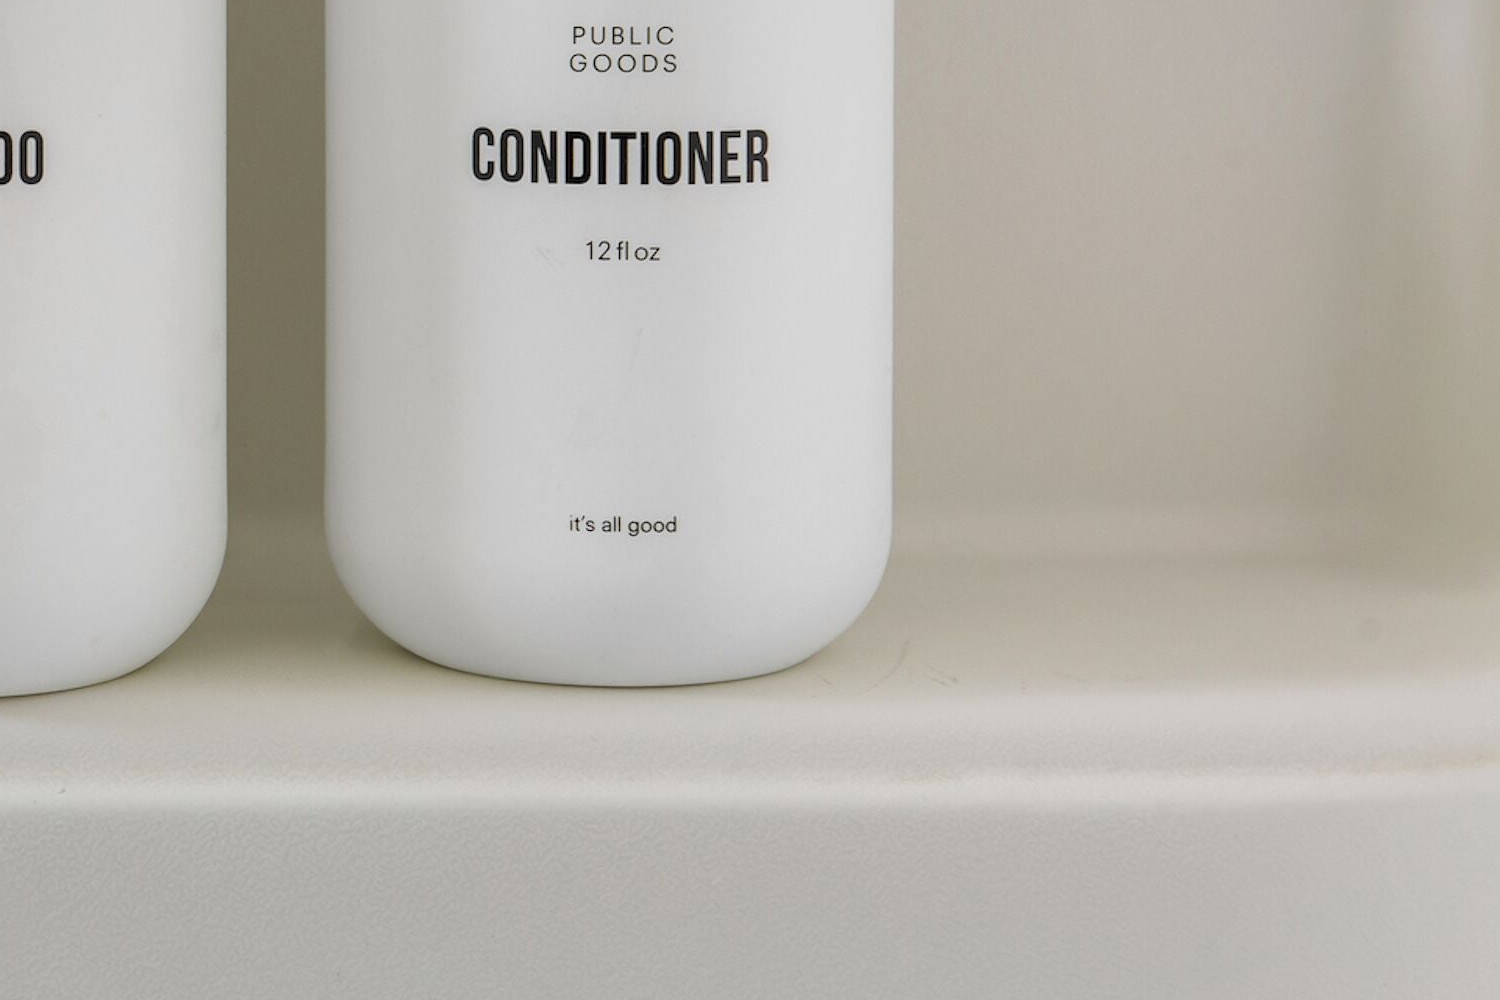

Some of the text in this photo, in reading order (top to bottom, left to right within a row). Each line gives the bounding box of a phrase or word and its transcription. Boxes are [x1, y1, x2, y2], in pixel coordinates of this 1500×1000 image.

[572, 25, 675, 46] PUBLIC
[569, 52, 678, 73] GOODS
[471, 126, 770, 186] CONDITIONER
[585, 240, 661, 262] 12 fl oz
[569, 514, 678, 537] it's all good
